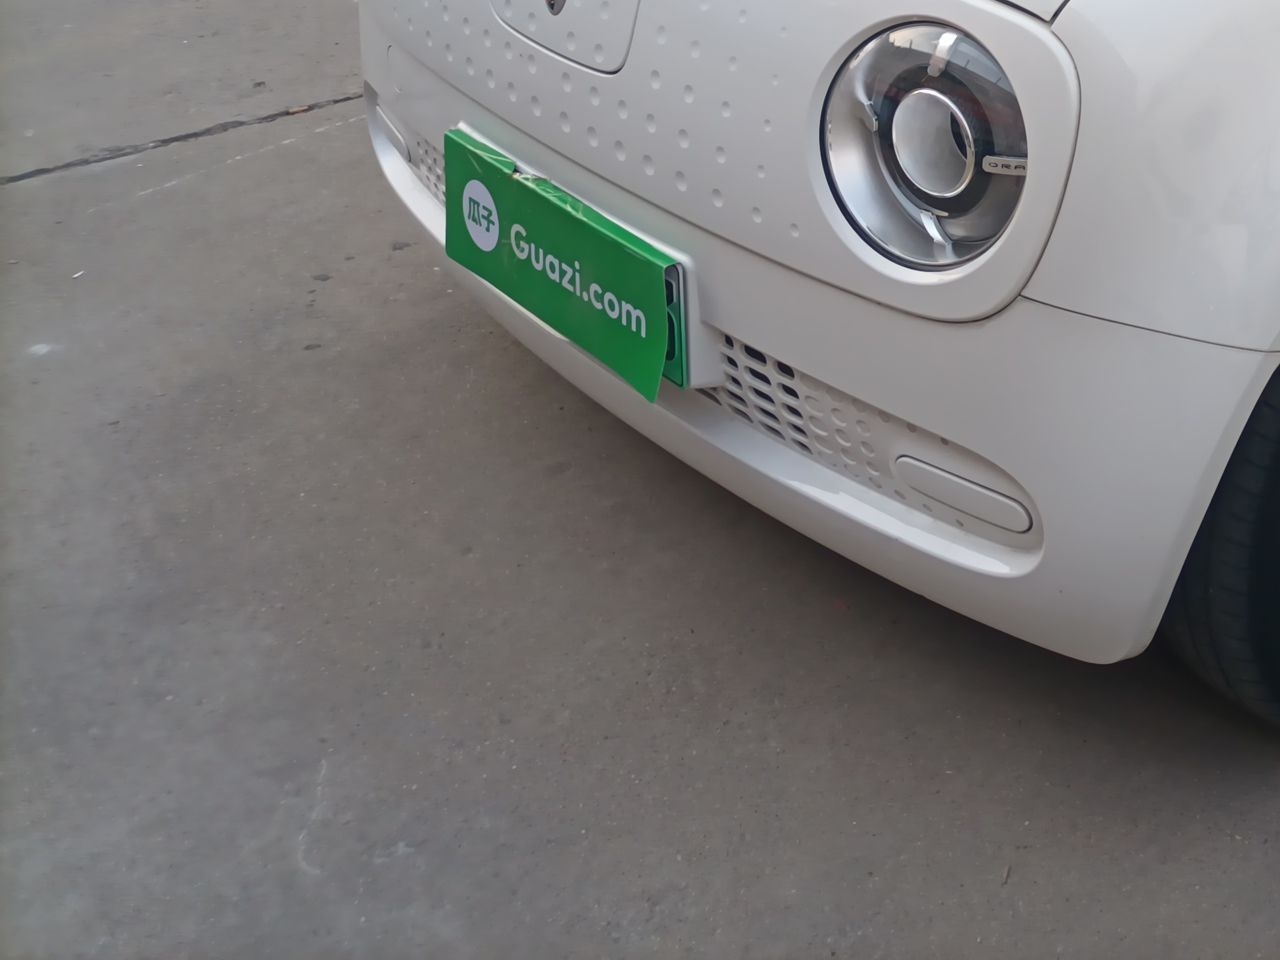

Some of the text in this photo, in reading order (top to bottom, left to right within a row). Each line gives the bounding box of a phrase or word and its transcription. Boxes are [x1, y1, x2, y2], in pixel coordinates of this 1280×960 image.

[988, 162, 1026, 171] ORA
[468, 196, 495, 233] 瓜子
[510, 223, 646, 338] Guazi.com
